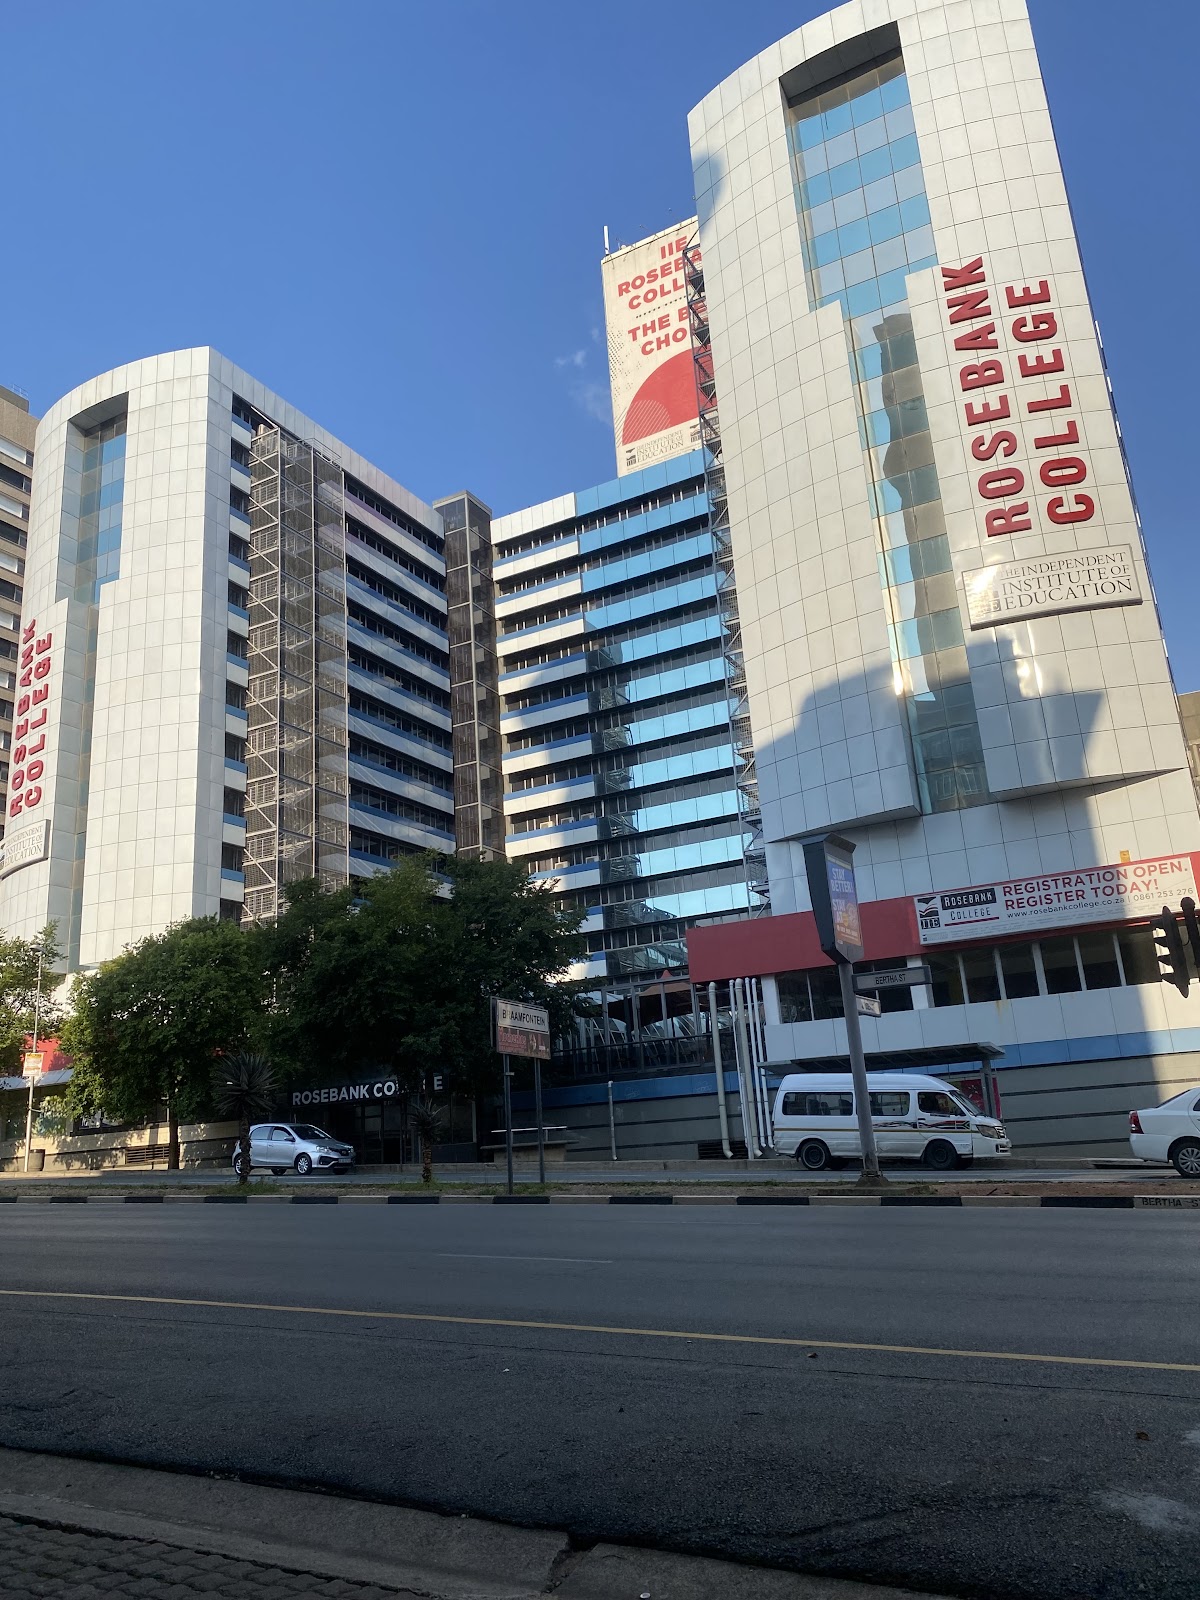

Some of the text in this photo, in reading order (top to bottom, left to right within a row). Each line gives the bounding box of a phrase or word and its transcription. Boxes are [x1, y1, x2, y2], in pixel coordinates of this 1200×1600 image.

[661, 236, 687, 259] IIE
[618, 249, 702, 297] ROSEBA
[629, 278, 685, 310] COLL
[628, 314, 670, 341] THE
[641, 327, 688, 355] CHO
[941, 256, 1032, 537] ROSEBANK
[1005, 280, 1095, 525] COLLEGE
[637, 438, 678, 456] INSTITUTE
[637, 441, 684, 462] EDUCATION
[1021, 552, 1126, 576] INDEPENDENT
[1002, 564, 1130, 595] INSTITUTE OF
[1005, 578, 1133, 610] EDUCATION
[10, 619, 36, 817] ROSEBANK
[25, 633, 52, 808] COLLEGE
[1003, 861, 1187, 896] REGISTRATION OPEN.
[944, 892, 992, 907] ROSEBANK
[1005, 879, 1158, 910] REGISTER TODAY!
[1007, 898, 1125, 918] www.rosebankcollege.co.za
[1133, 893, 1154, 902] 0861
[1157, 890, 1174, 898] 253
[1177, 888, 1193, 896] 276
[950, 907, 991, 920] COLLEGE
[875, 974, 906, 984] BERTHA ST
[503, 1009, 545, 1026] BRAAMFONTEIN
[292, 1084, 369, 1105] ROSEBANK
[1142, 1197, 1200, 1207] BERTHA S
